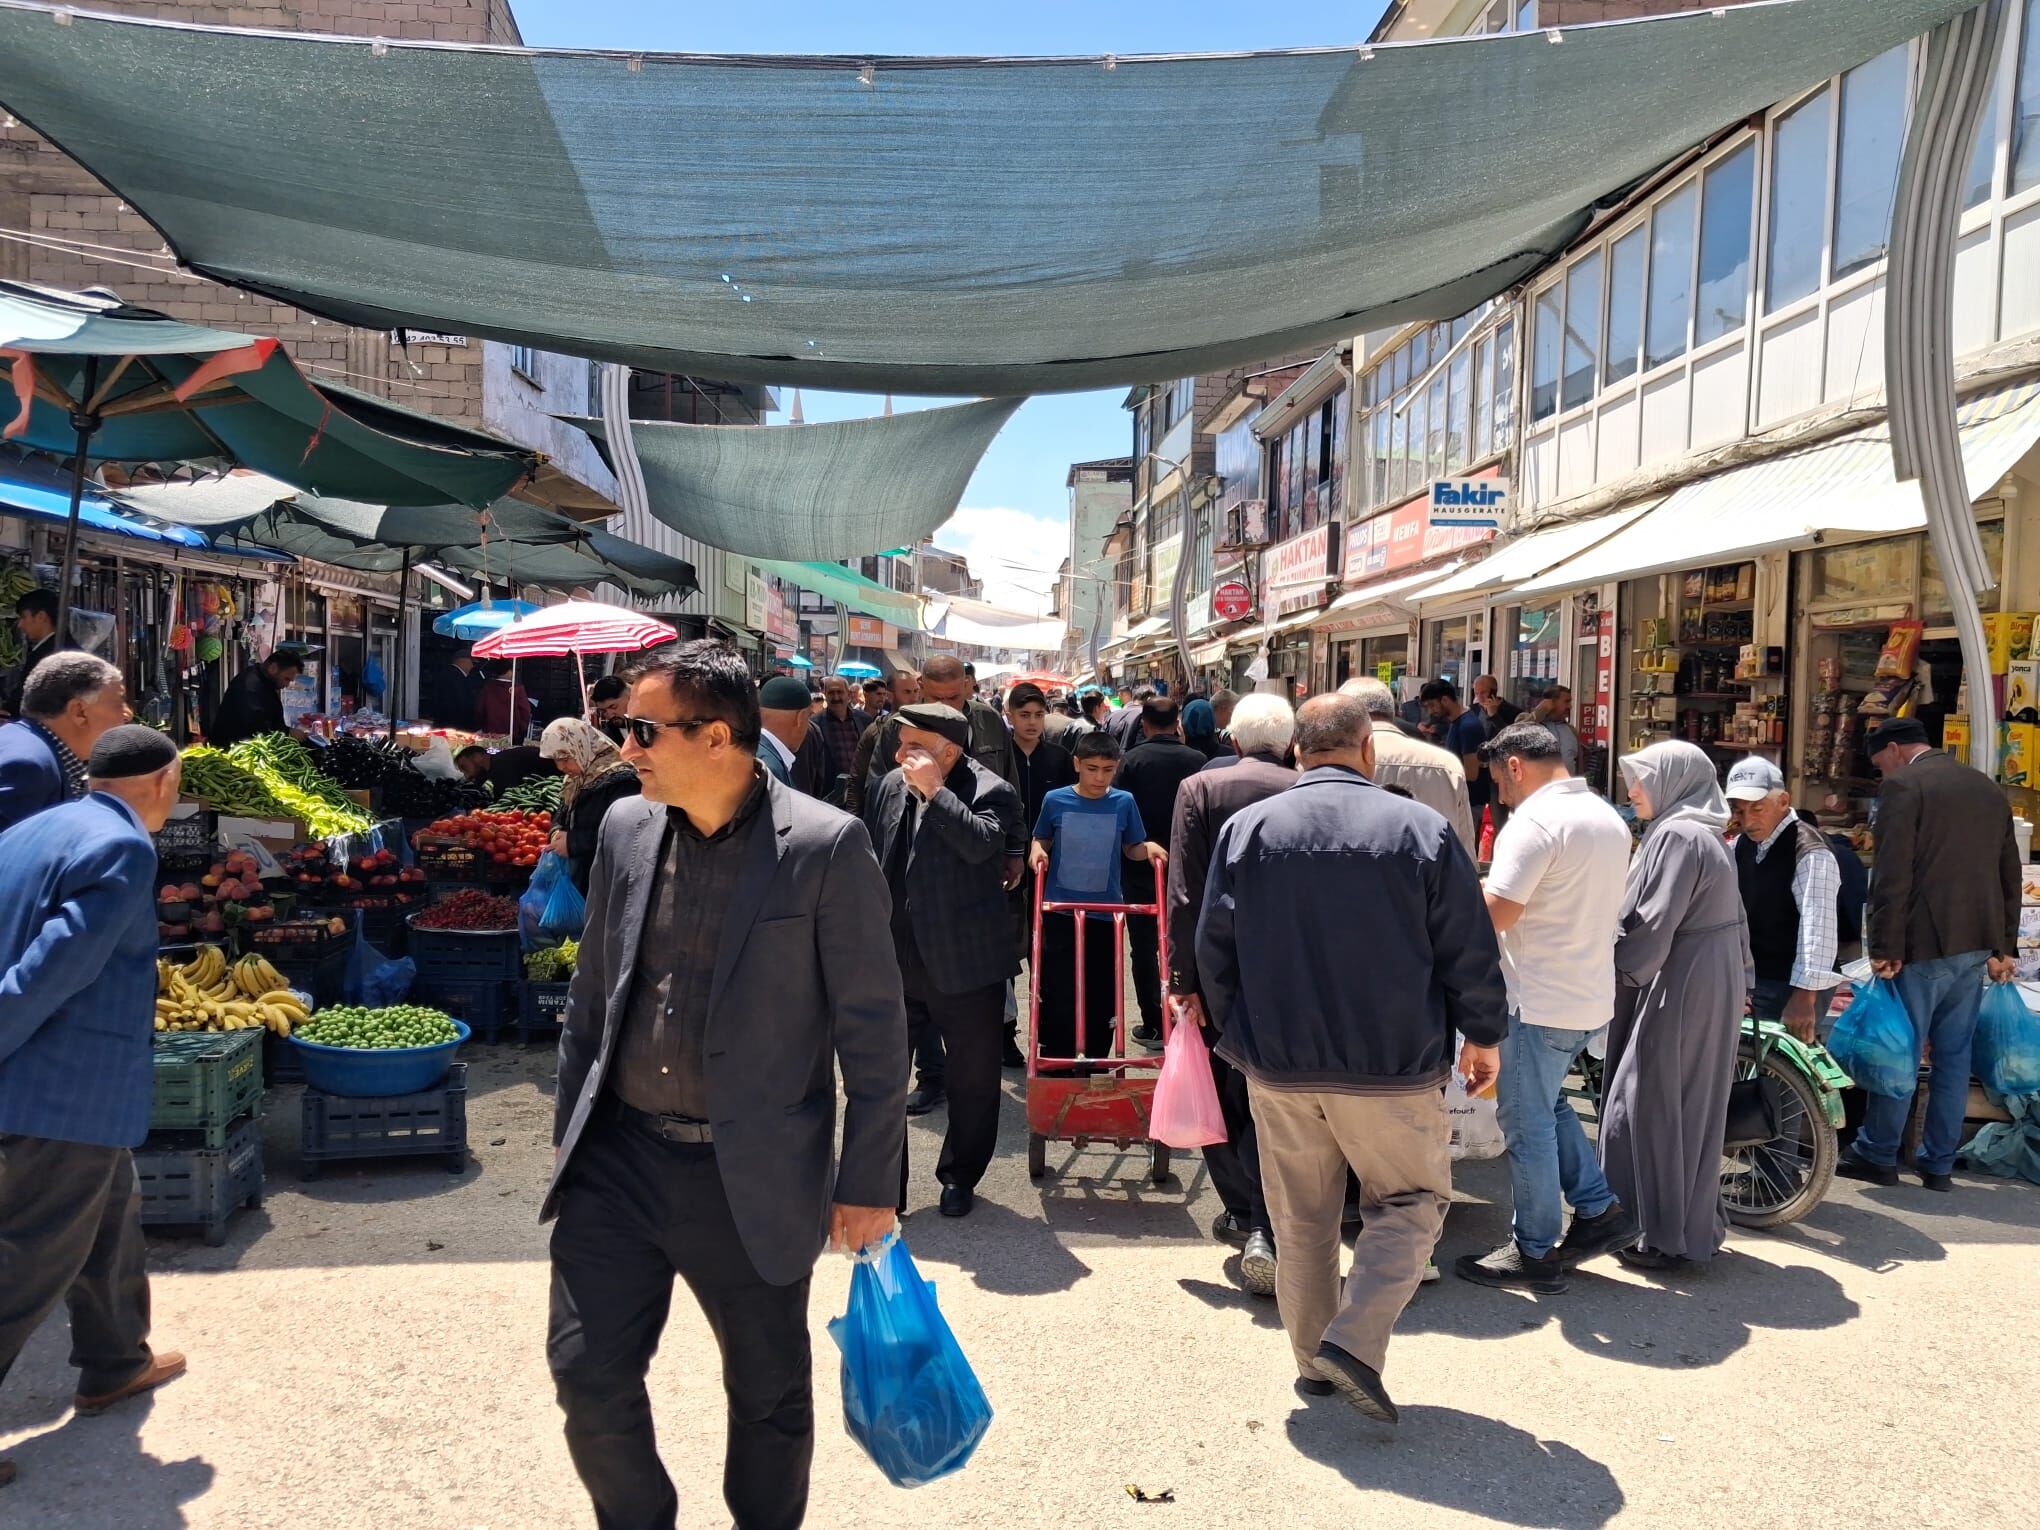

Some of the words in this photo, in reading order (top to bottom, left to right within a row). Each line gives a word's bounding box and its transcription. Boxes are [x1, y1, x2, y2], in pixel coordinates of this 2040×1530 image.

[1433, 482, 1507, 506] Fakir
[1280, 530, 1326, 571] HAKTAN
[2011, 665, 2032, 673] yonca
